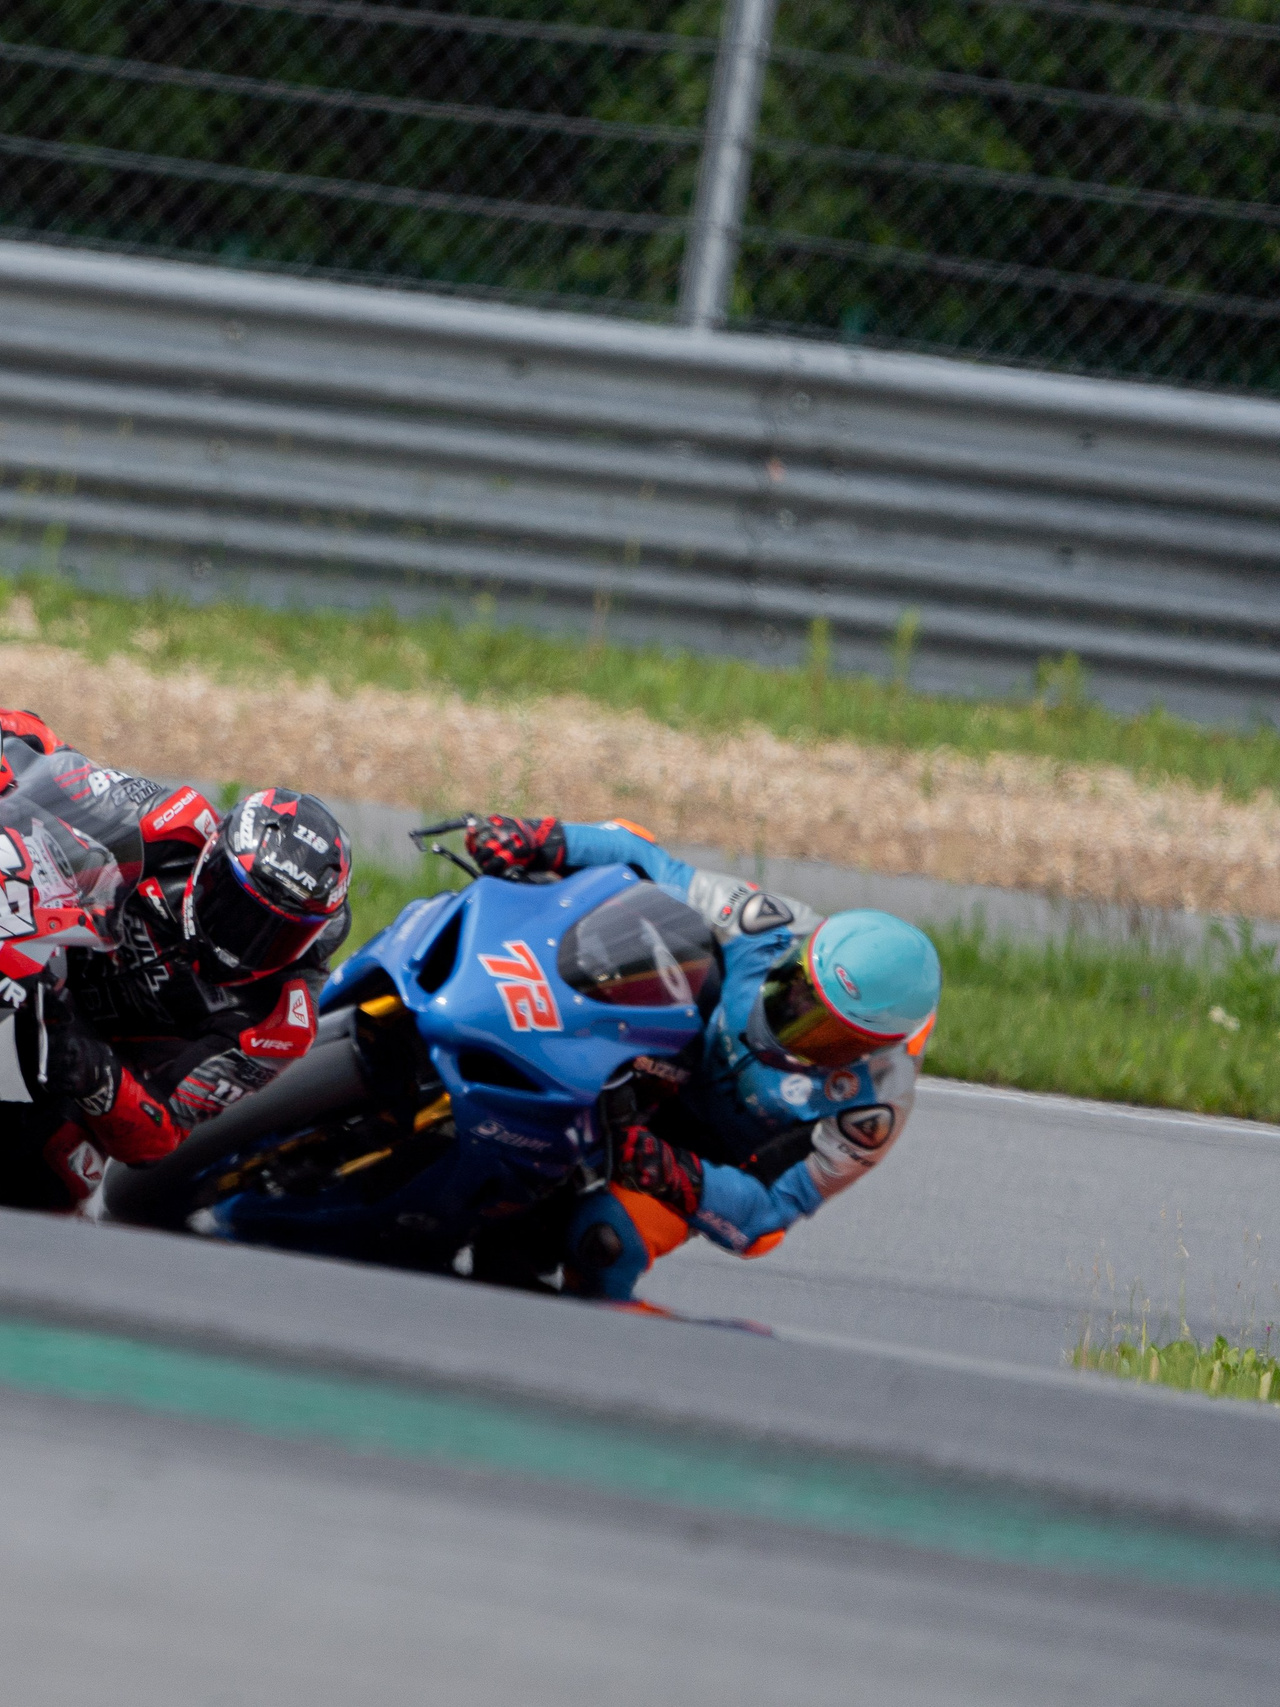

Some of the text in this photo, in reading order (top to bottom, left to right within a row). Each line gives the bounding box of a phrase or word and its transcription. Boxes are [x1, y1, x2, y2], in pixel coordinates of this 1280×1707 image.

[153, 789, 200, 830] VIRCOS
[266, 851, 318, 892] LAVR
[478, 940, 564, 1032] 72
